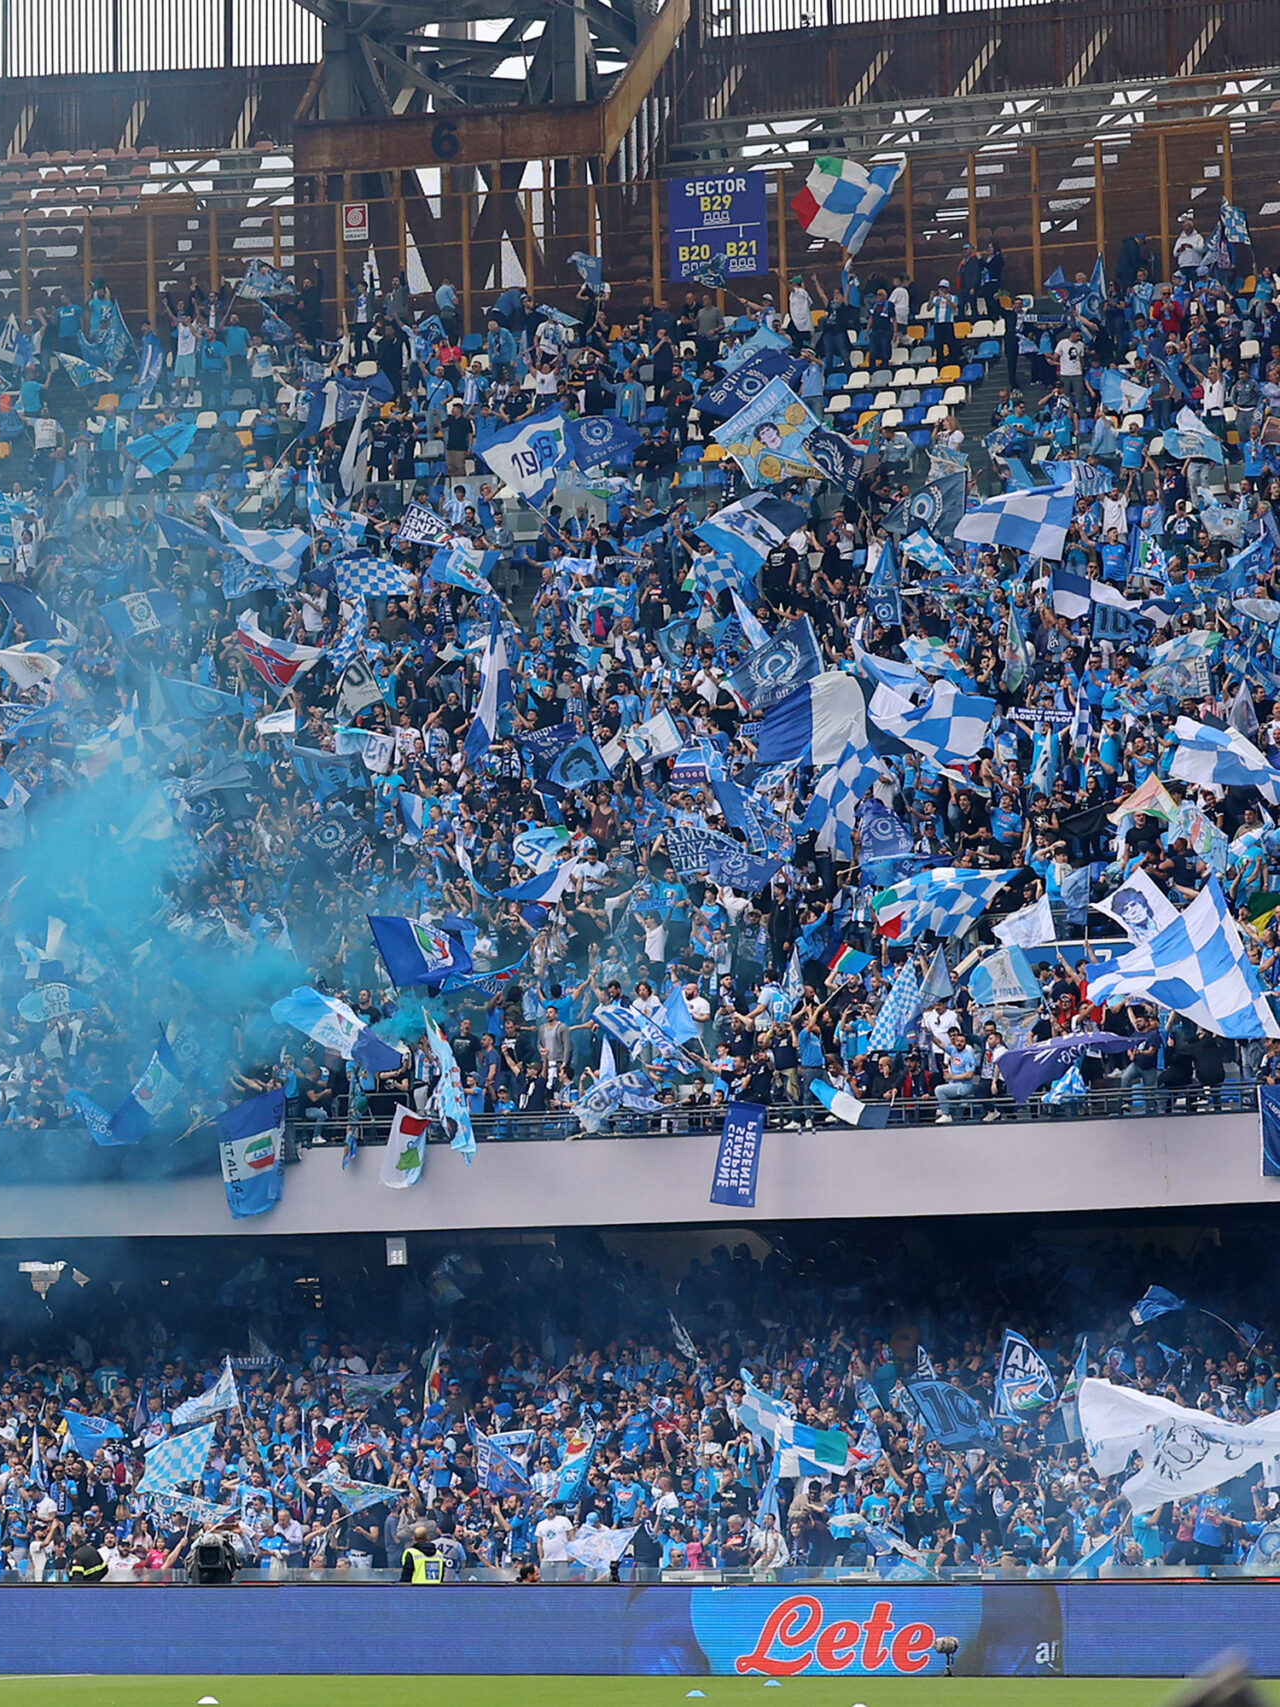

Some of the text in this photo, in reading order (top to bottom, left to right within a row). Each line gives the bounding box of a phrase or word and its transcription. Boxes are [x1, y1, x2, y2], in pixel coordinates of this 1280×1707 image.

[431, 121, 459, 160] 6
[685, 178, 746, 196] SECTOR
[700, 194, 732, 211] B29
[678, 240, 757, 262] B20 B21
[1075, 463, 1095, 481] 10
[405, 517, 438, 535] SENZA
[669, 840, 718, 858] SENZA
[670, 853, 709, 870] FINE
[223, 1140, 244, 1195] ITALIA
[101, 1376, 118, 1394] 10
[917, 1384, 979, 1437] 10
[734, 1594, 936, 1675] Lete
